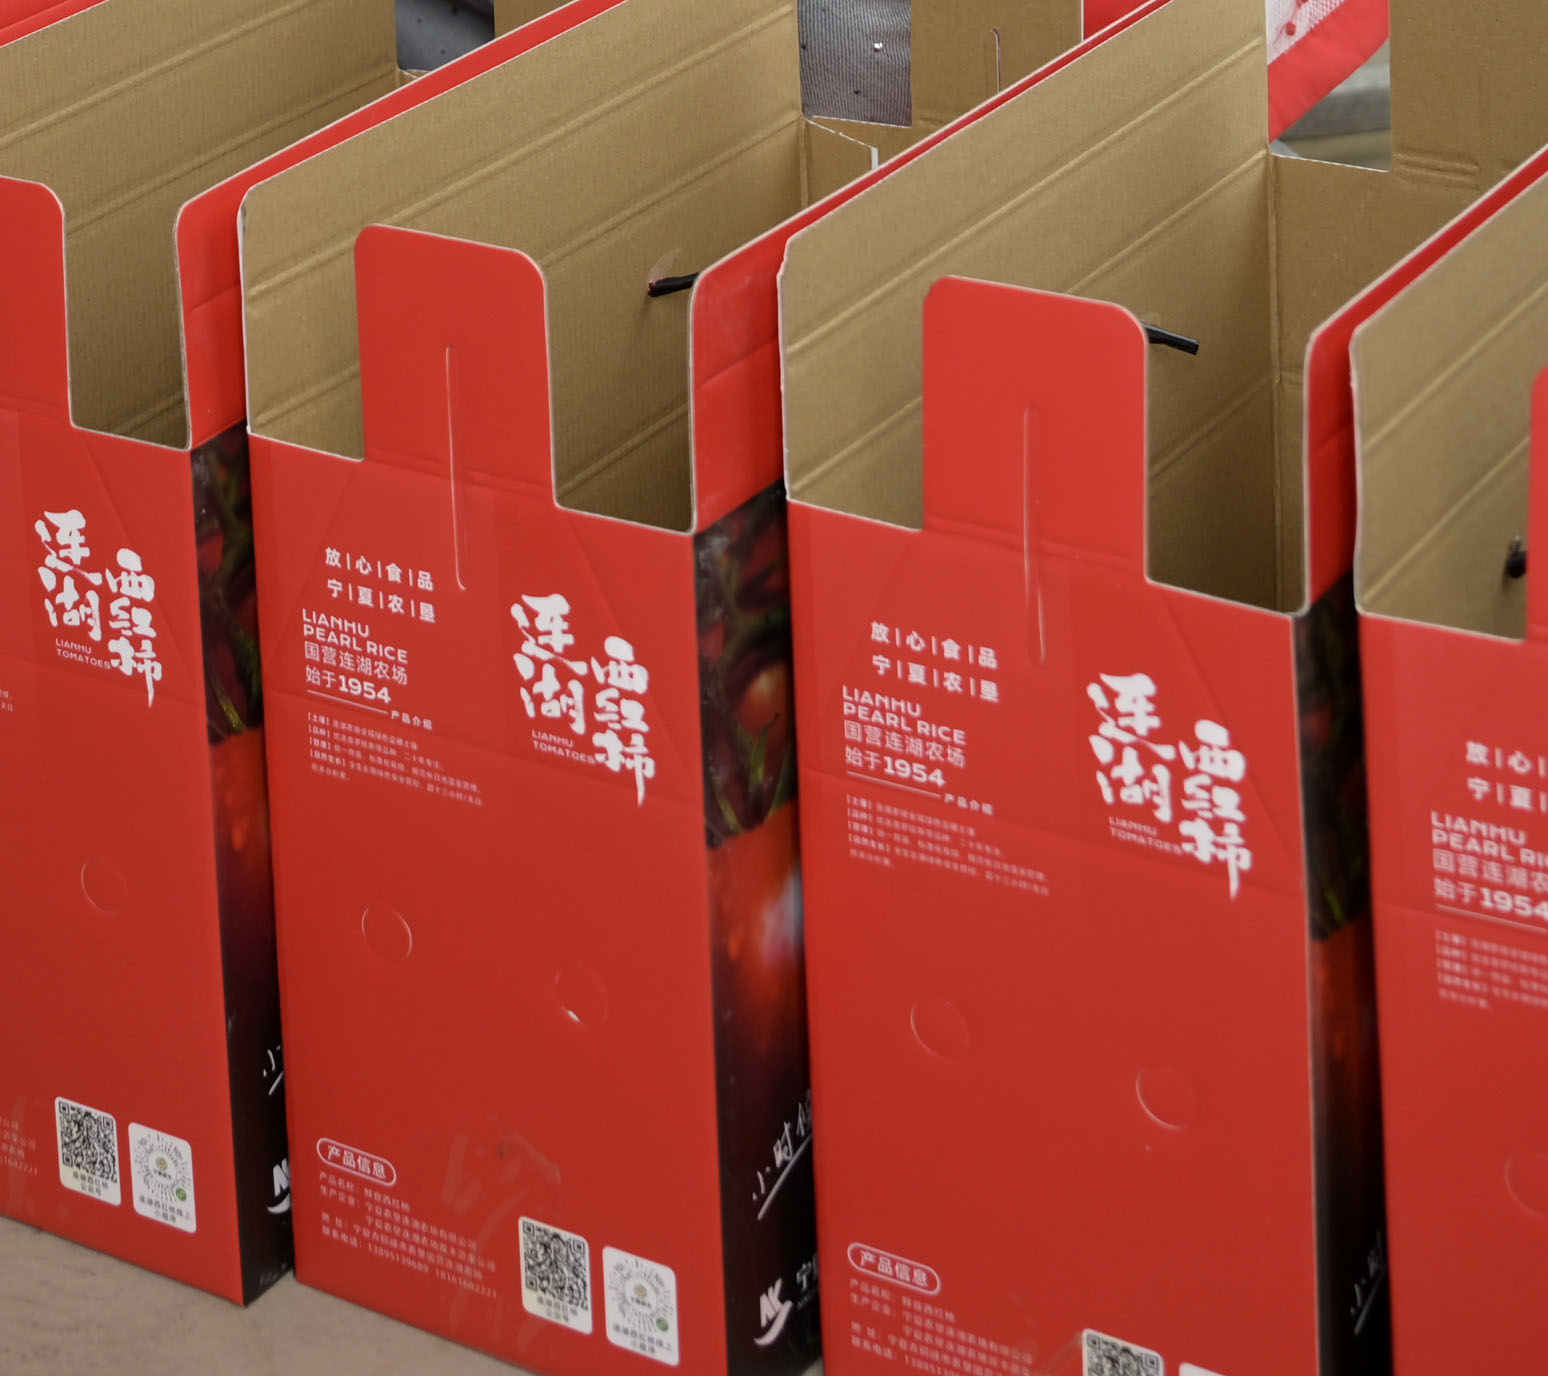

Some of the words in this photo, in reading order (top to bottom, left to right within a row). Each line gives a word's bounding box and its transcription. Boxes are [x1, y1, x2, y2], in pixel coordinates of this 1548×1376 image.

[302, 608, 370, 637] LIANHU
[55, 638, 92, 654] LIANHU
[304, 624, 363, 651] PEARL
[366, 640, 409, 664] RICE
[304, 641, 408, 686] 国营连湖农场
[305, 665, 392, 704] 始于1954
[842, 684, 922, 719] LIANHU
[531, 729, 575, 749] LIANHU
[844, 702, 912, 732] PEARL
[916, 719, 966, 746] RICE
[844, 719, 965, 769] 国营连湖农场
[845, 745, 946, 789] 始于1954
[1430, 810, 1526, 846] LIANHU
[1432, 830, 1514, 862] PEARL
[327, 1145, 387, 1180] 产品信息
[859, 1250, 928, 1288] 产品信息
